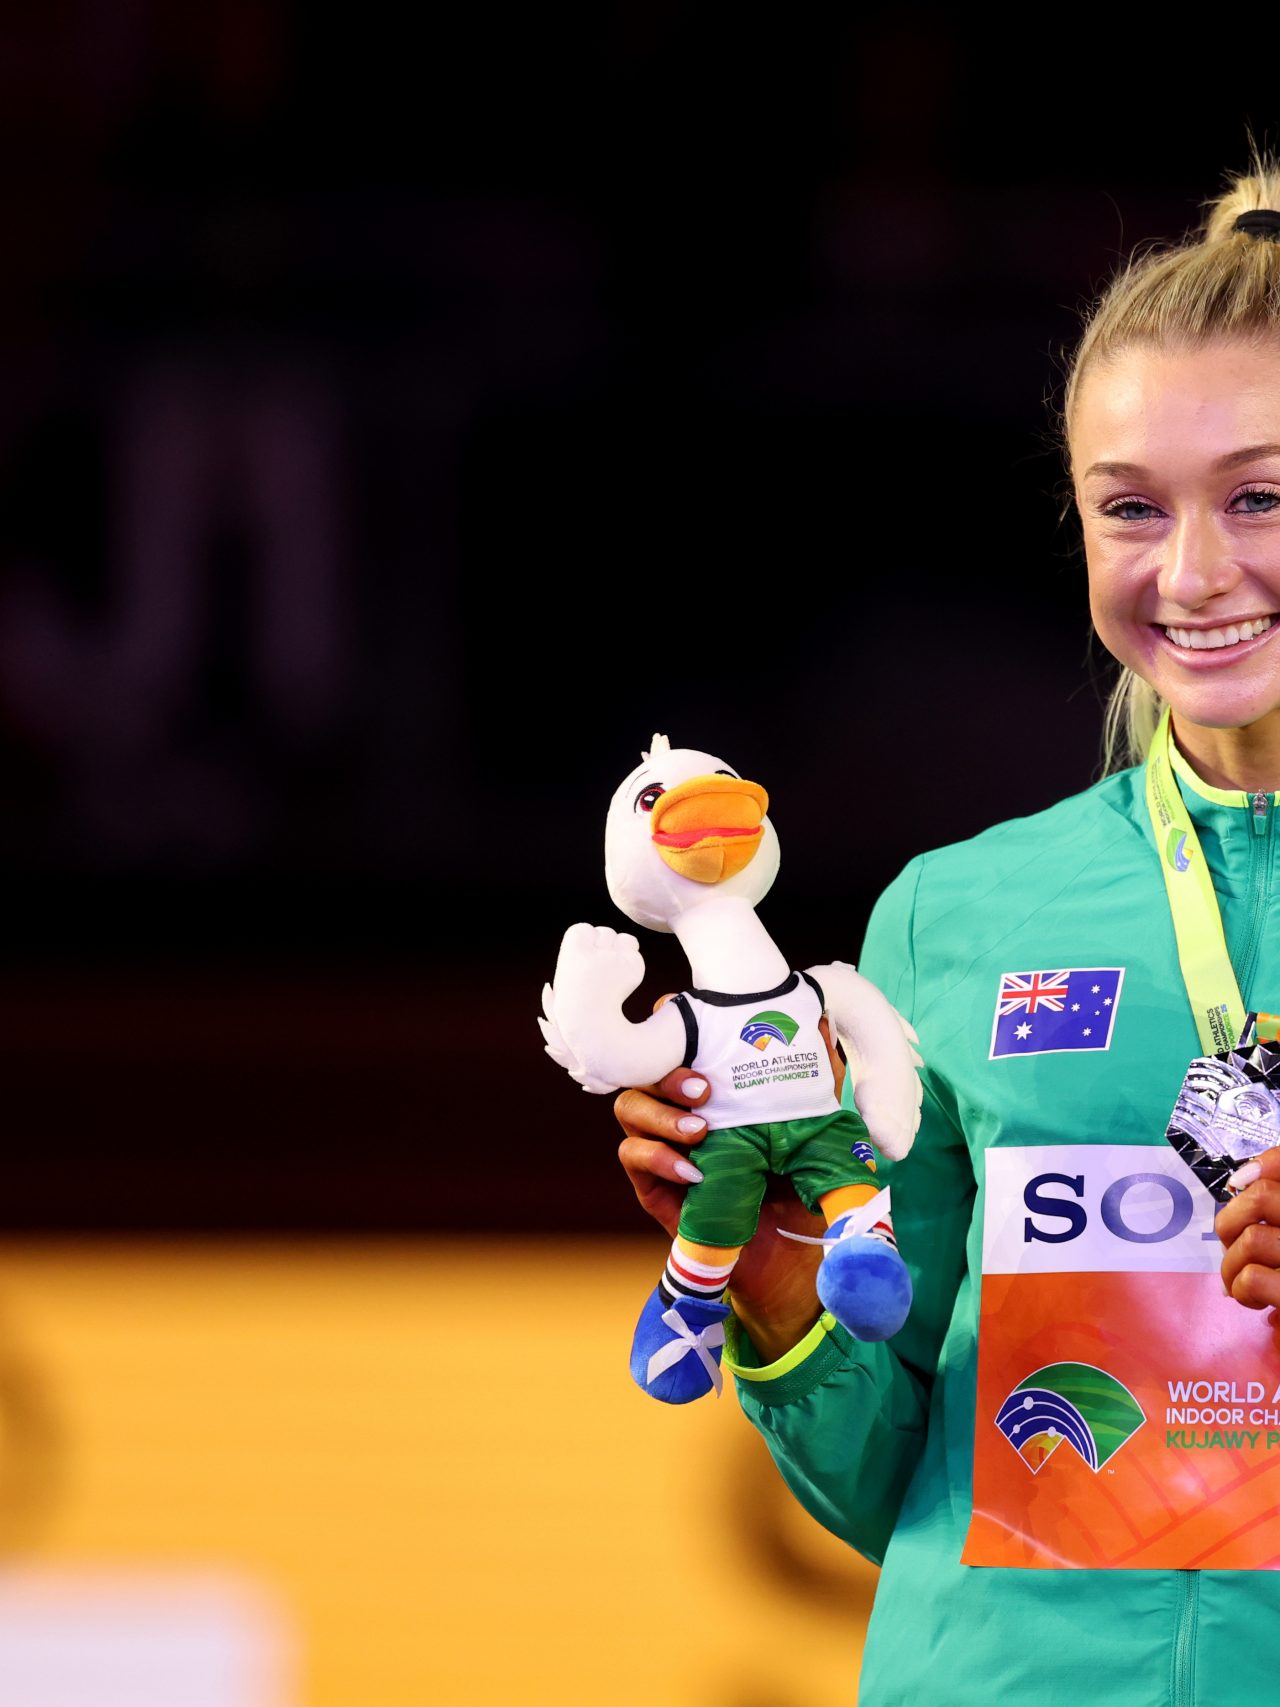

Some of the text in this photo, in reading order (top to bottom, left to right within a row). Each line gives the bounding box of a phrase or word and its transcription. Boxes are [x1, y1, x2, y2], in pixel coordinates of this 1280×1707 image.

[1206, 1008, 1223, 1046] ATHLETICS
[731, 1052, 818, 1074] WORLD ATHLETICS
[732, 1062, 819, 1081] INDOOR CHAMPIONSHIPS
[734, 1077, 771, 1090] KUJAWY
[773, 1070, 810, 1082] POMORZE
[1167, 1381, 1265, 1404] WORLD
[1166, 1408, 1245, 1426] INDOOR
[1166, 1430, 1262, 1450] KUJAWY
